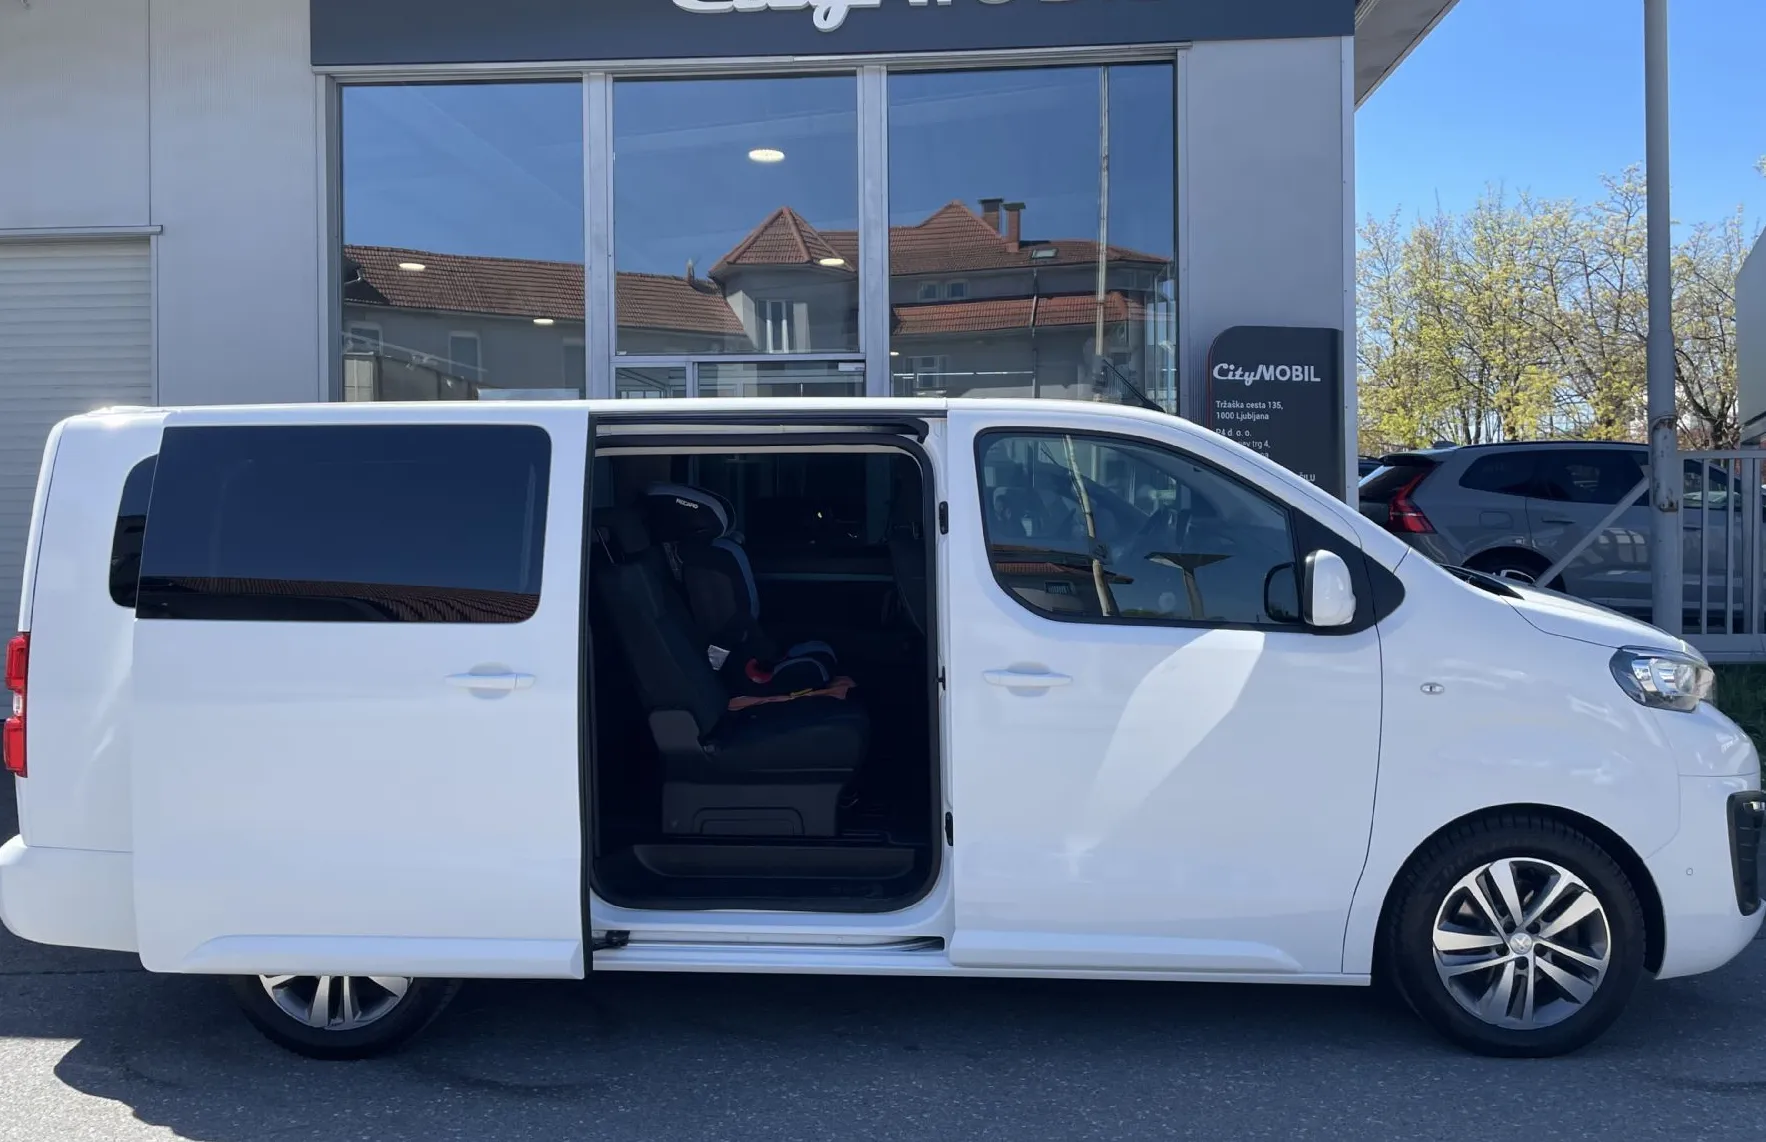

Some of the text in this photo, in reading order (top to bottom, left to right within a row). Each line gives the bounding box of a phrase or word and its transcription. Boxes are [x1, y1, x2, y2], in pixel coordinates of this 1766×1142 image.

[1215, 400, 1284, 410] Tržaška cesta 135,
[1216, 411, 1269, 422] 1000 Ljubljana
[1252, 440, 1263, 449] trg
